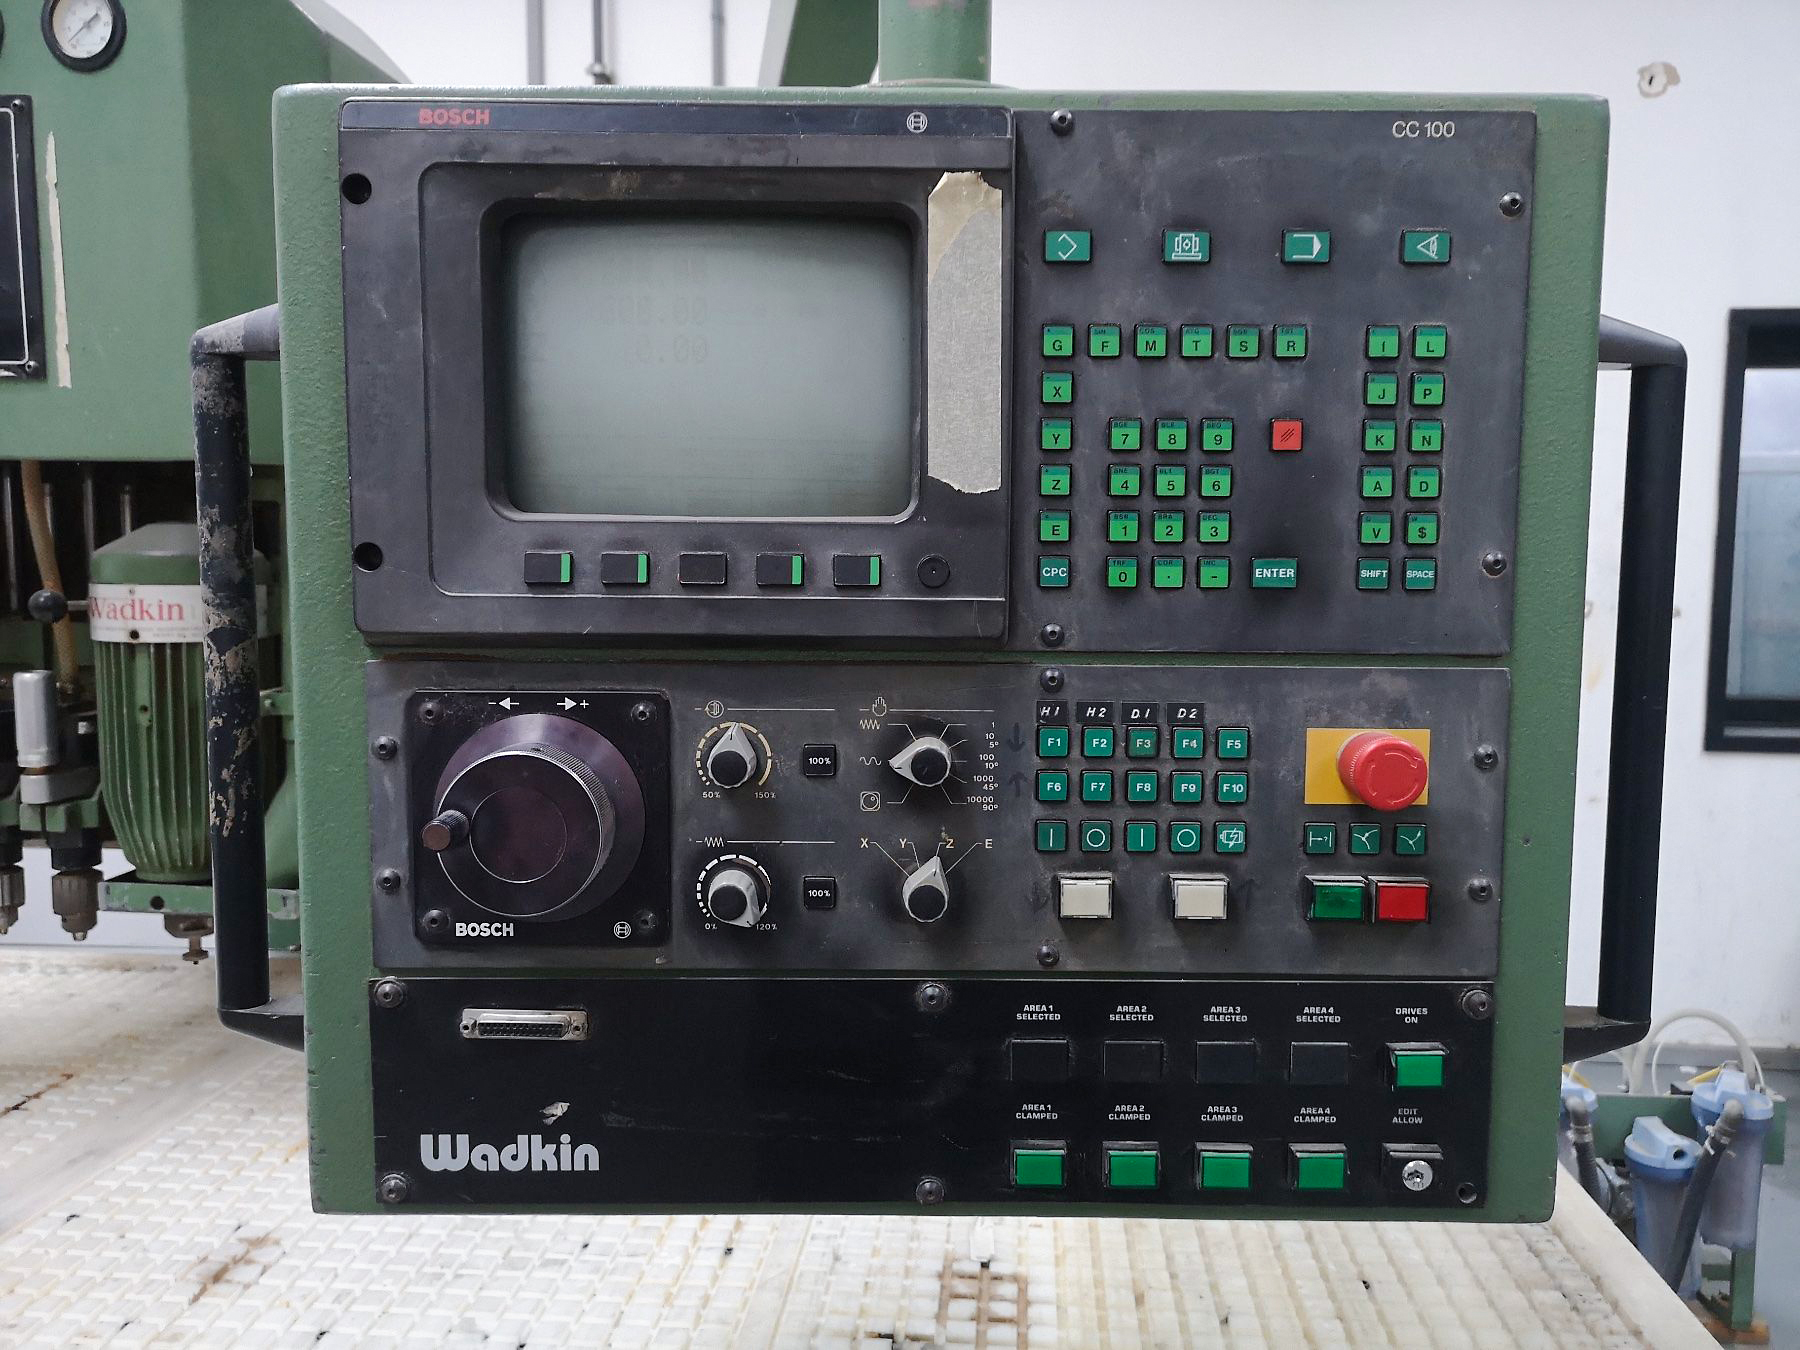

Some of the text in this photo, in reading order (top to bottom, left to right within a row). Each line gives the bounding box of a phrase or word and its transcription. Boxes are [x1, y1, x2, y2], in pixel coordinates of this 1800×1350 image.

[419, 108, 490, 125] BOSCH
[1392, 121, 1455, 138] CC 100
[1052, 340, 1063, 352] G
[1101, 340, 1110, 352] F
[1145, 340, 1157, 352] M
[1192, 340, 1201, 351] T
[1239, 340, 1248, 352] S
[1286, 340, 1296, 352] R
[1426, 341, 1435, 352] L
[1053, 386, 1062, 397] X
[1378, 388, 1386, 400] J
[1423, 388, 1432, 399] P
[1052, 433, 1061, 444] Y
[1121, 434, 1130, 444] 7
[1168, 434, 1177, 444] 8
[1213, 434, 1223, 445] 9
[1375, 434, 1385, 446] K
[1421, 435, 1432, 446] N
[1052, 480, 1061, 491] Z
[1120, 480, 1129, 490] 4
[1167, 480, 1175, 491] 5
[1212, 480, 1221, 491] 6
[1373, 481, 1382, 492] A
[1419, 481, 1429, 492] D
[1051, 525, 1061, 535] E
[1165, 525, 1174, 536] 2
[1210, 526, 1218, 537] 3
[1372, 527, 1381, 538] V
[1418, 526, 1426, 539] $
[1042, 567, 1068, 577] CPC
[1255, 568, 1295, 578] ENTER
[1360, 570, 1388, 578] SHIFT
[1406, 570, 1435, 578] SPACE
[87, 596, 184, 621] Wadkin
[1047, 737, 1061, 747] F1
[1092, 738, 1107, 748] F2
[1136, 739, 1151, 748] F3
[1182, 739, 1198, 749] F4
[1226, 739, 1242, 749] F5
[808, 757, 832, 765] 100%
[979, 753, 995, 761] 100
[1047, 783, 1062, 792] F6
[1090, 783, 1105, 792] F7
[1136, 783, 1151, 792] F8
[1181, 783, 1196, 793] F9
[1223, 783, 1244, 793] F10
[702, 791, 721, 799] 50%
[754, 791, 776, 799] 150%
[860, 838, 869, 848] X
[899, 838, 907, 848] Y
[945, 839, 955, 849] Z
[985, 839, 993, 848] E
[808, 889, 831, 897] 100%
[455, 922, 514, 937] BOSCH
[756, 923, 778, 931] 120%
[1395, 1007, 1428, 1015] DRIVES
[1016, 1013, 1061, 1021] SELECTED
[1296, 1015, 1341, 1023] SELECTED
[1404, 1016, 1418, 1024] ON
[1015, 1112, 1058, 1120] CLAMPED
[1201, 1114, 1243, 1122] CLAMPED
[1294, 1115, 1336, 1123] CLAMPED
[1392, 1116, 1423, 1124] ALLOW
[420, 1133, 600, 1172] Wadkin
